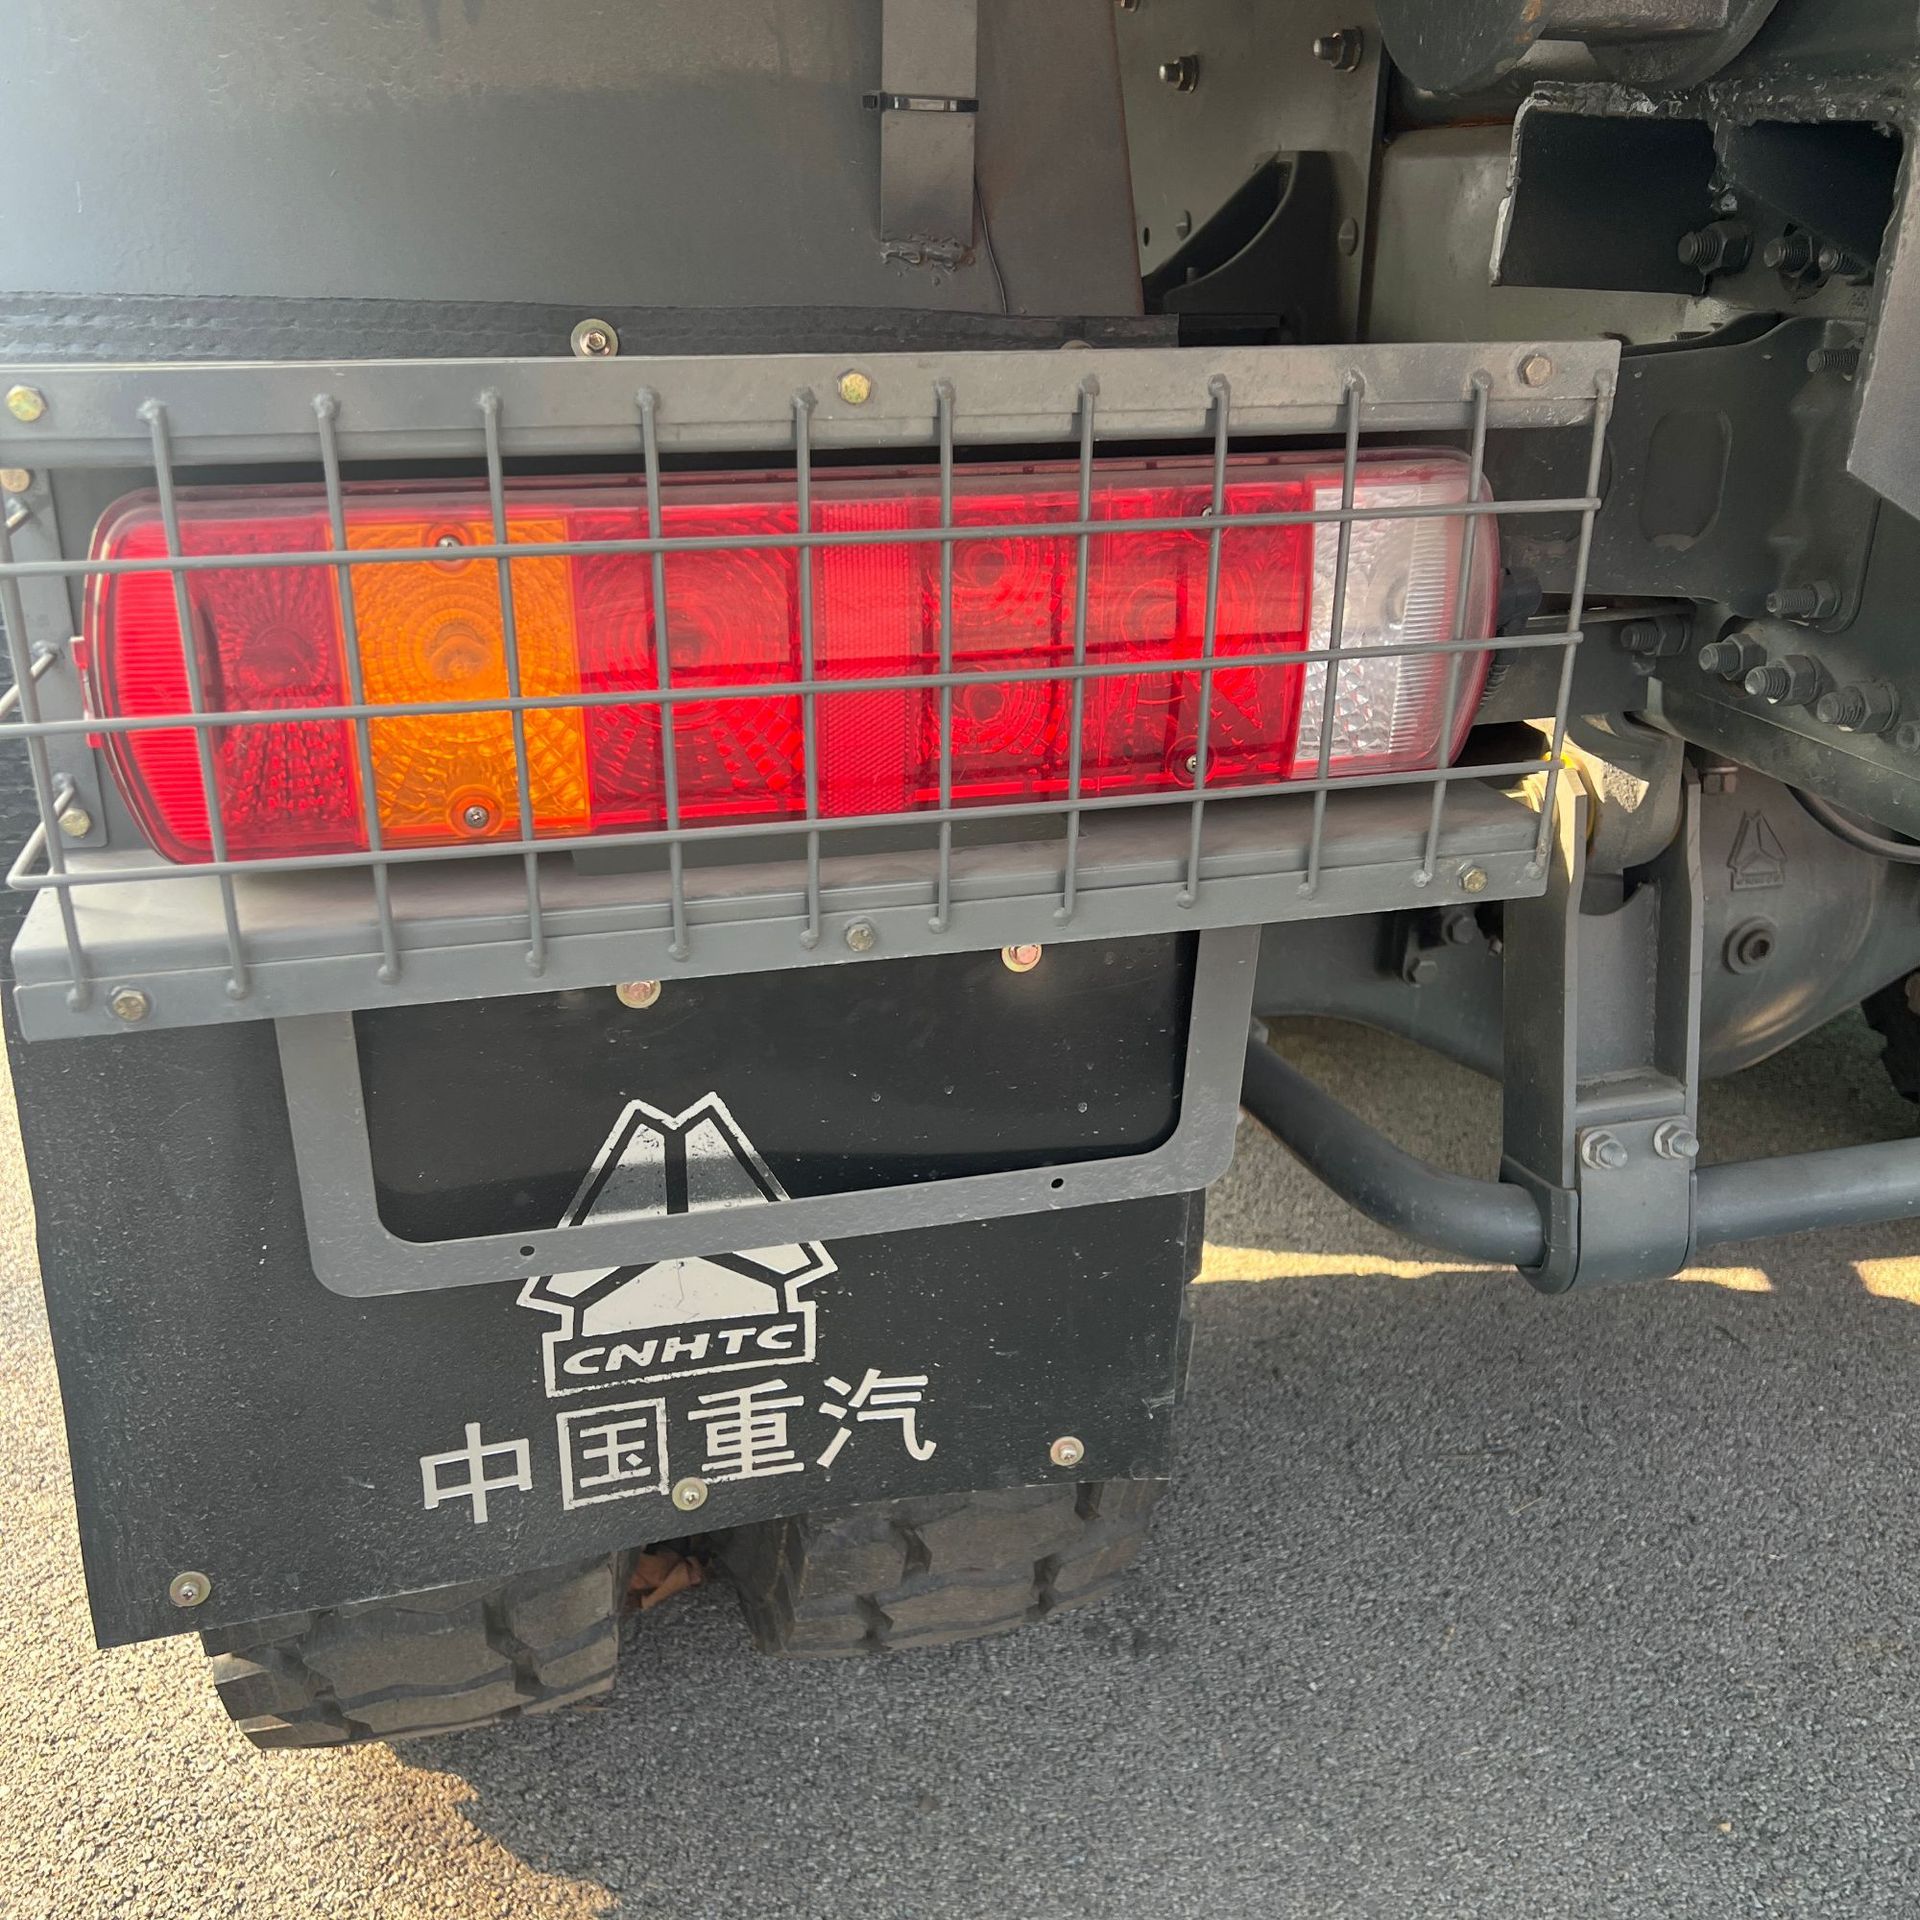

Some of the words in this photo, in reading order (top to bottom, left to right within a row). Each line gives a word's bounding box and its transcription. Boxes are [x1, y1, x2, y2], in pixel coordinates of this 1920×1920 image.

[563, 1323, 798, 1374] CNHTC
[419, 1369, 937, 1523] 中国重汽
